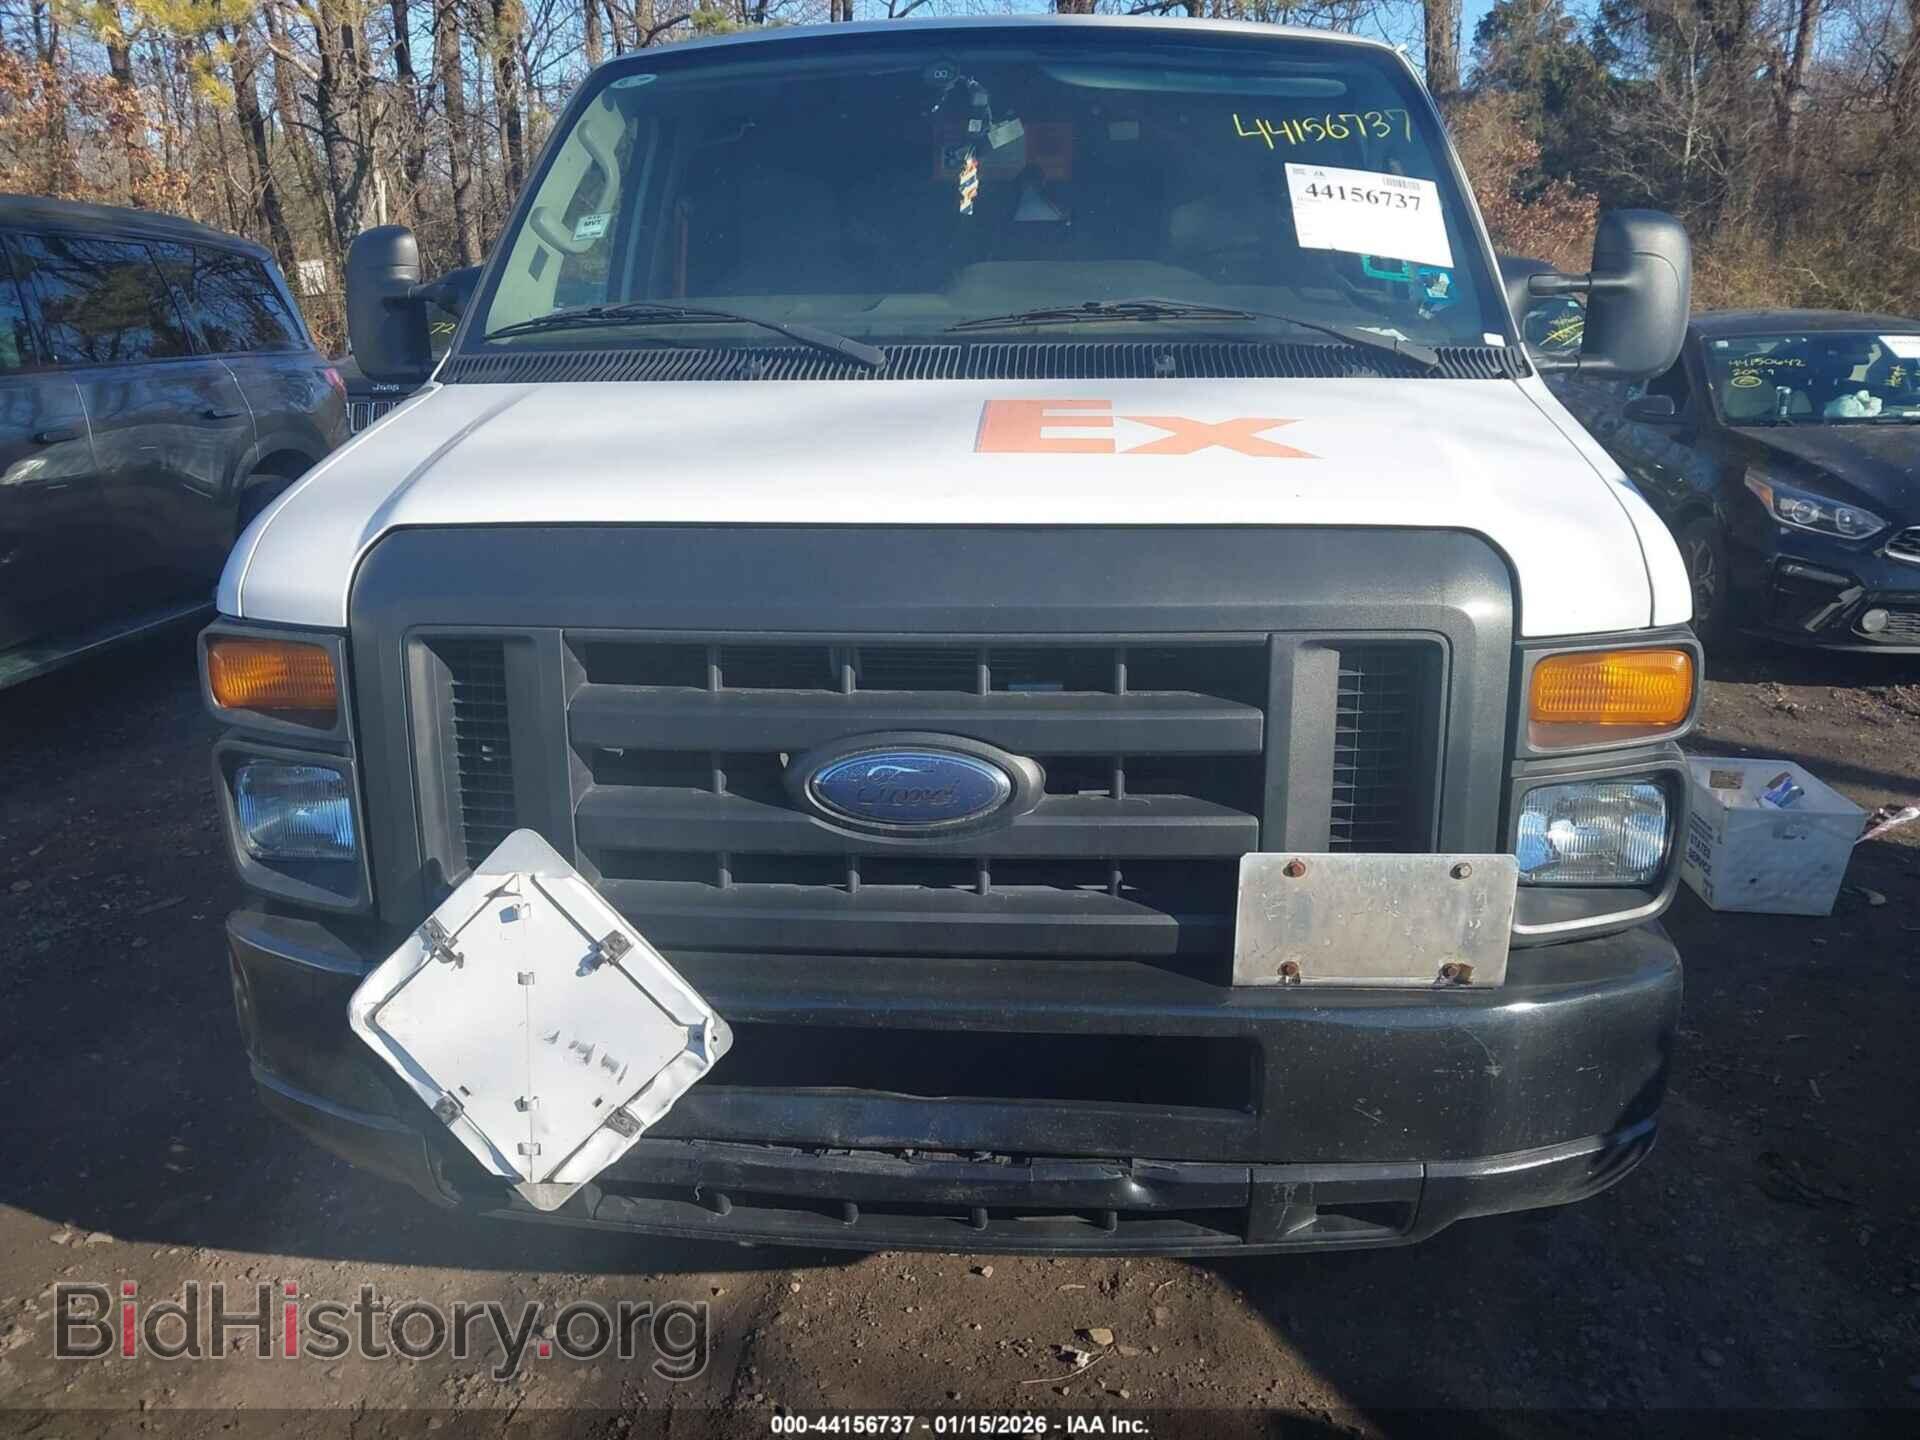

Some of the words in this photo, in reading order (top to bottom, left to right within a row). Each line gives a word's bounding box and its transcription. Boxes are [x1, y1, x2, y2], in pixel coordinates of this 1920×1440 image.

[1233, 110, 1411, 149] 44156737
[1305, 183, 1421, 211] 44156737
[974, 397, 1325, 460] Ex
